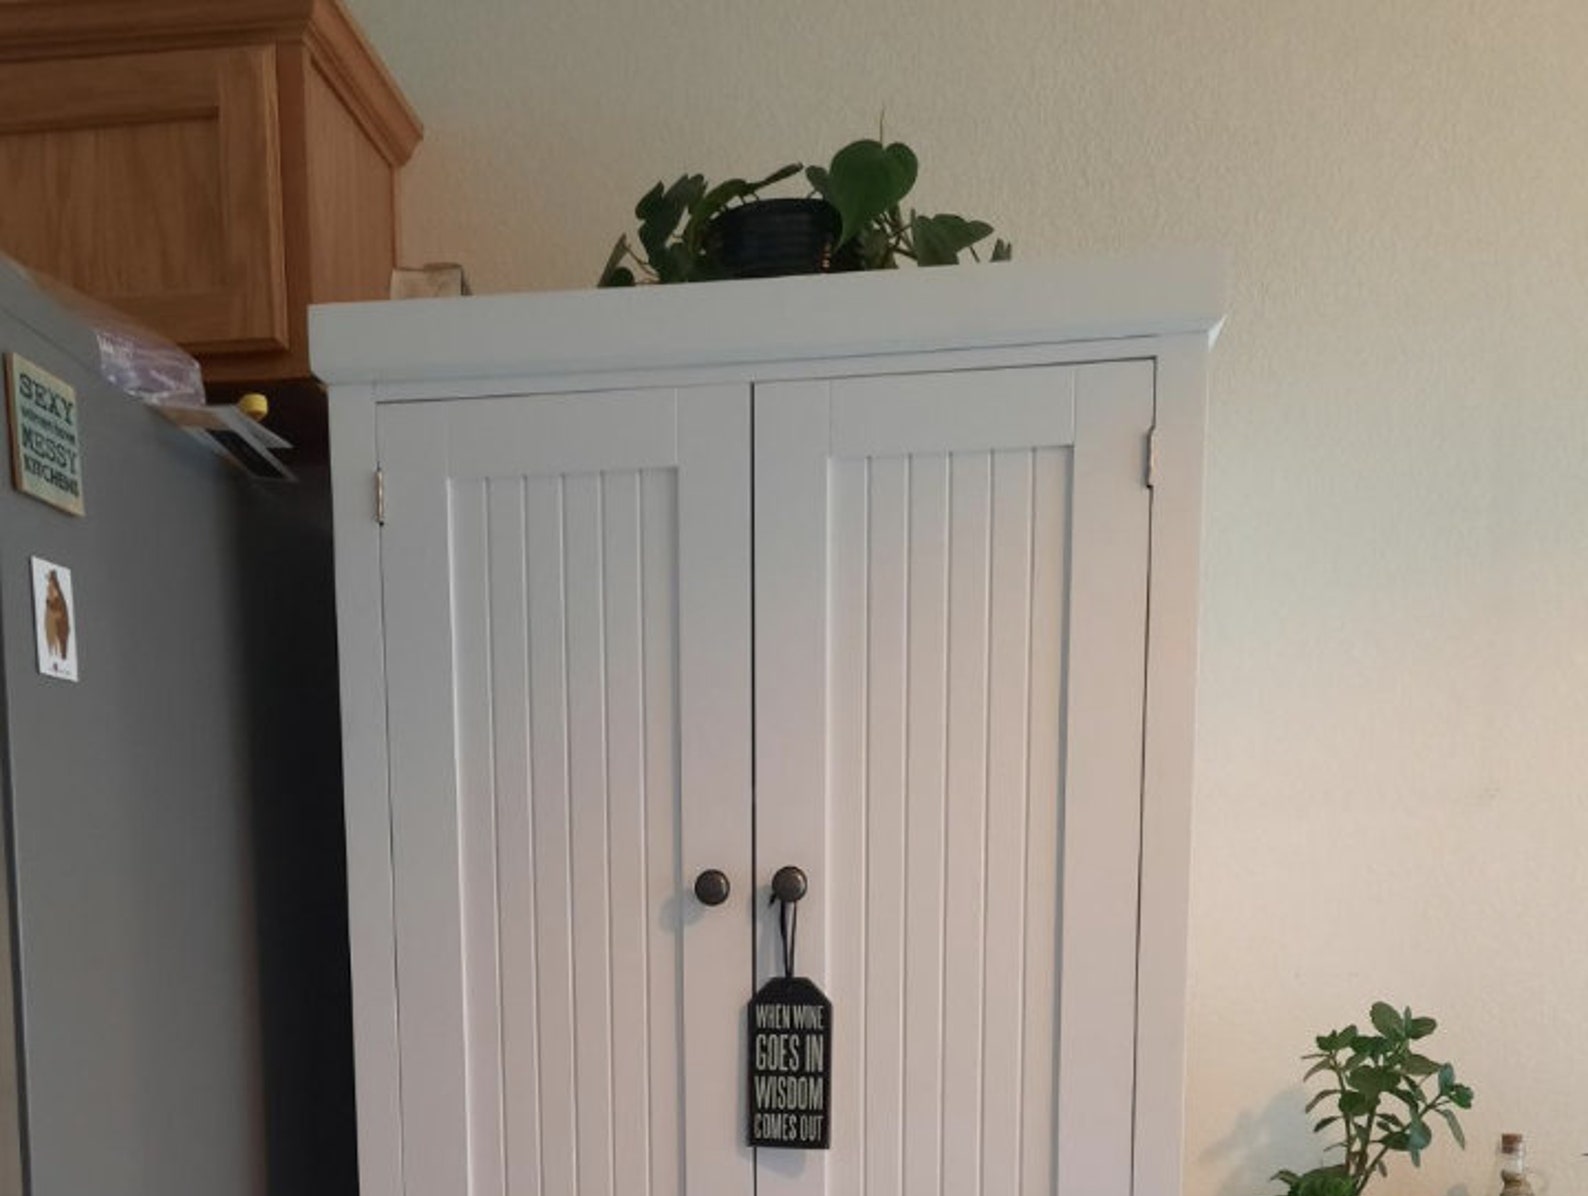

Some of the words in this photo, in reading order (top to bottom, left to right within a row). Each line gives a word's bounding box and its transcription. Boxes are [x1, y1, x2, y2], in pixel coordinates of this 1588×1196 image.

[19, 373, 74, 425] SEXY
[22, 424, 77, 474] MESSY
[755, 1004, 790, 1029] WHEN
[793, 1005, 824, 1029] WINE
[755, 1033, 799, 1071] GOES
[806, 1034, 824, 1072] IN
[755, 1075, 824, 1110] WISDOM
[754, 1113, 798, 1140] COMES
[799, 1115, 824, 1142] OUT
